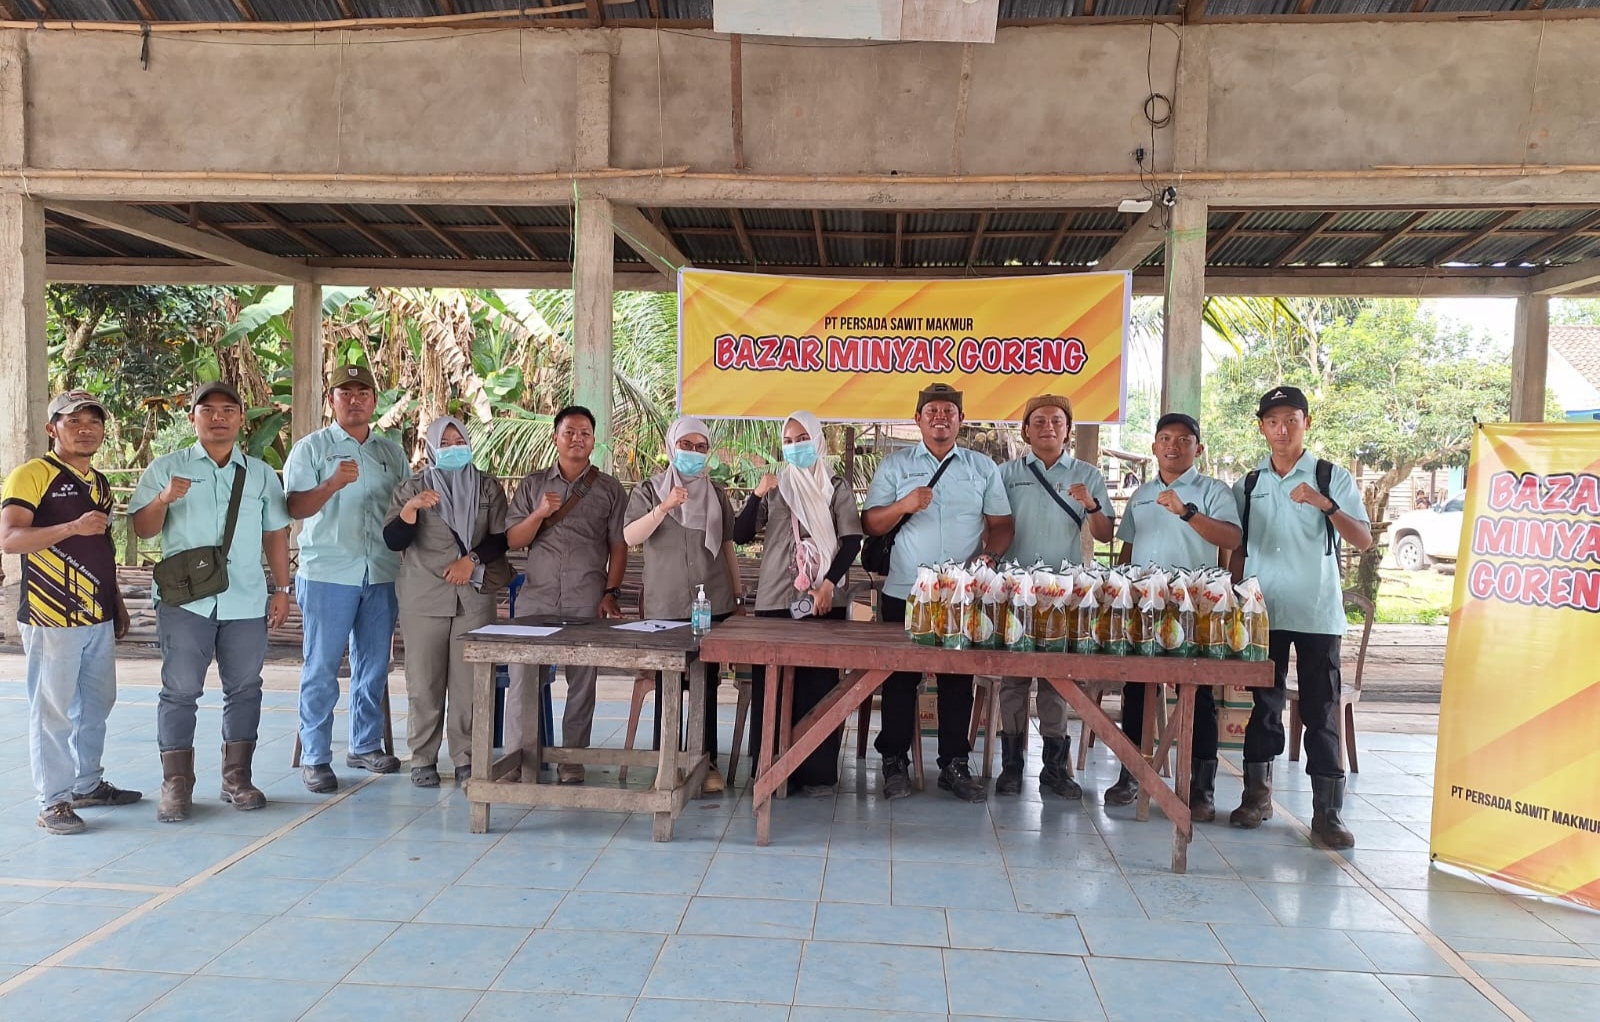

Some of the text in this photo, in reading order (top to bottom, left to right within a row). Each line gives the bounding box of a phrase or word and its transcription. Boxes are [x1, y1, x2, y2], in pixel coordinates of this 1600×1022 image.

[824, 316, 974, 331] PT PERSADA SAWIT MAKMUR
[715, 335, 1087, 374] BAZAR MINYAK GORENG
[1489, 472, 1600, 516] BAZA
[1469, 560, 1600, 612] GOREN
[1451, 785, 1464, 799] PT
[1465, 788, 1512, 812] PERSADA
[1514, 800, 1550, 821] SAWIT
